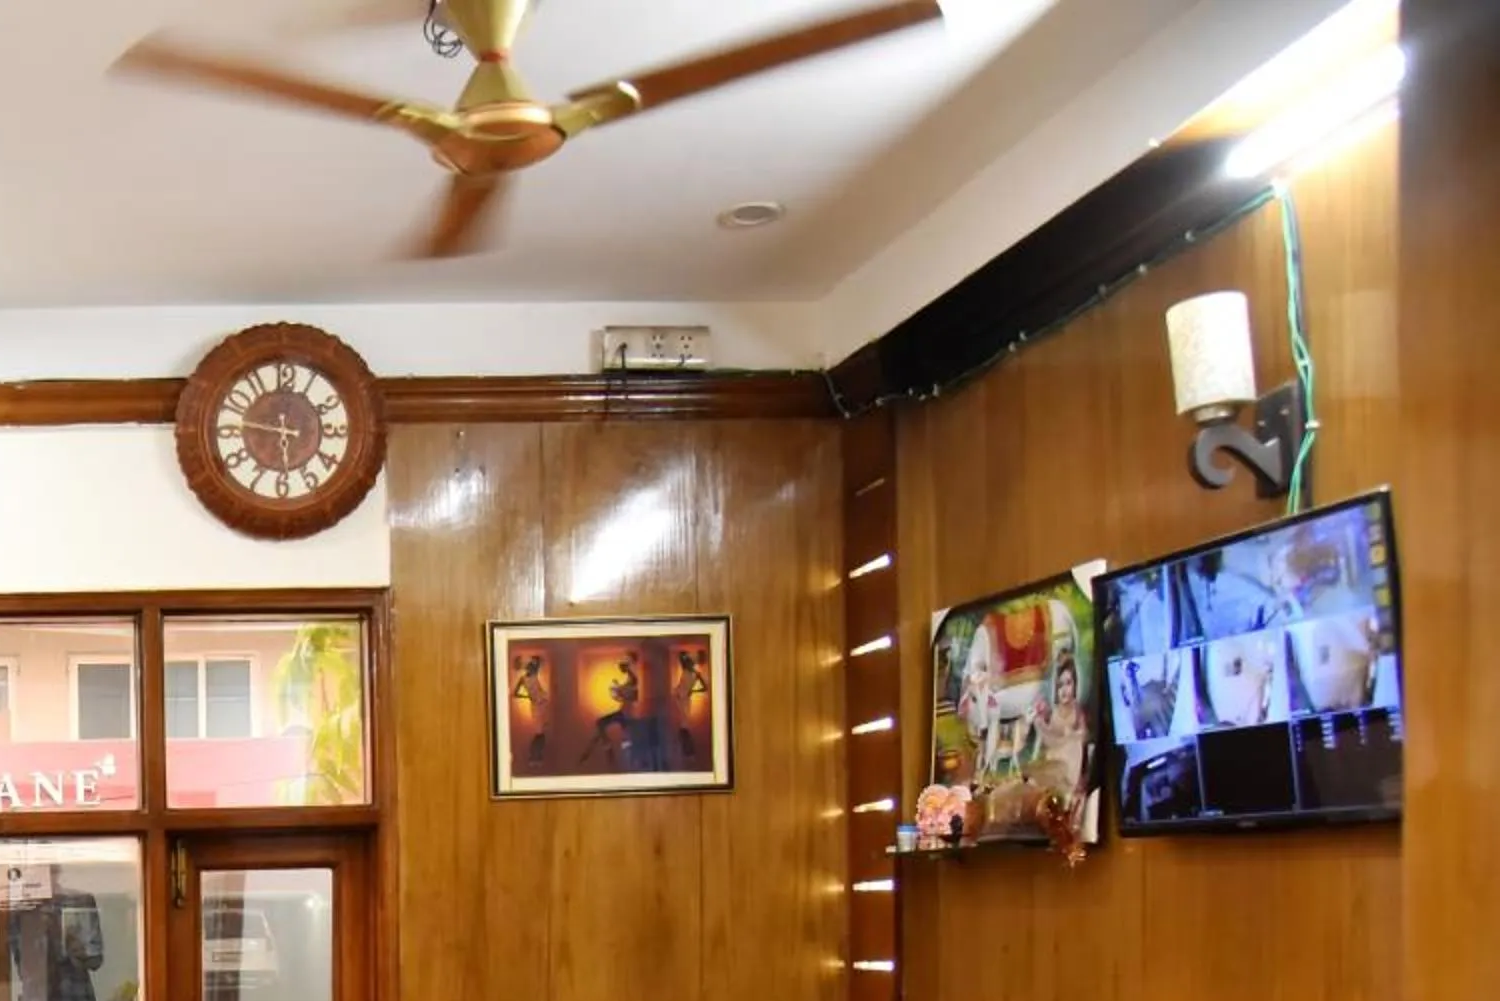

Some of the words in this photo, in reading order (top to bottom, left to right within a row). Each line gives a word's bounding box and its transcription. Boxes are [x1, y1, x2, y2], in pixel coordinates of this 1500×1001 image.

[246, 369, 265, 398] 11
[276, 363, 296, 390] 12
[223, 389, 251, 415] 10
[316, 394, 341, 415] 2
[218, 425, 243, 439] 9
[323, 422, 348, 438] 3
[225, 448, 250, 468] 8
[318, 452, 339, 473] 4
[250, 465, 266, 491] 7
[275, 472, 290, 498] 6
[301, 469, 320, 490] 5
